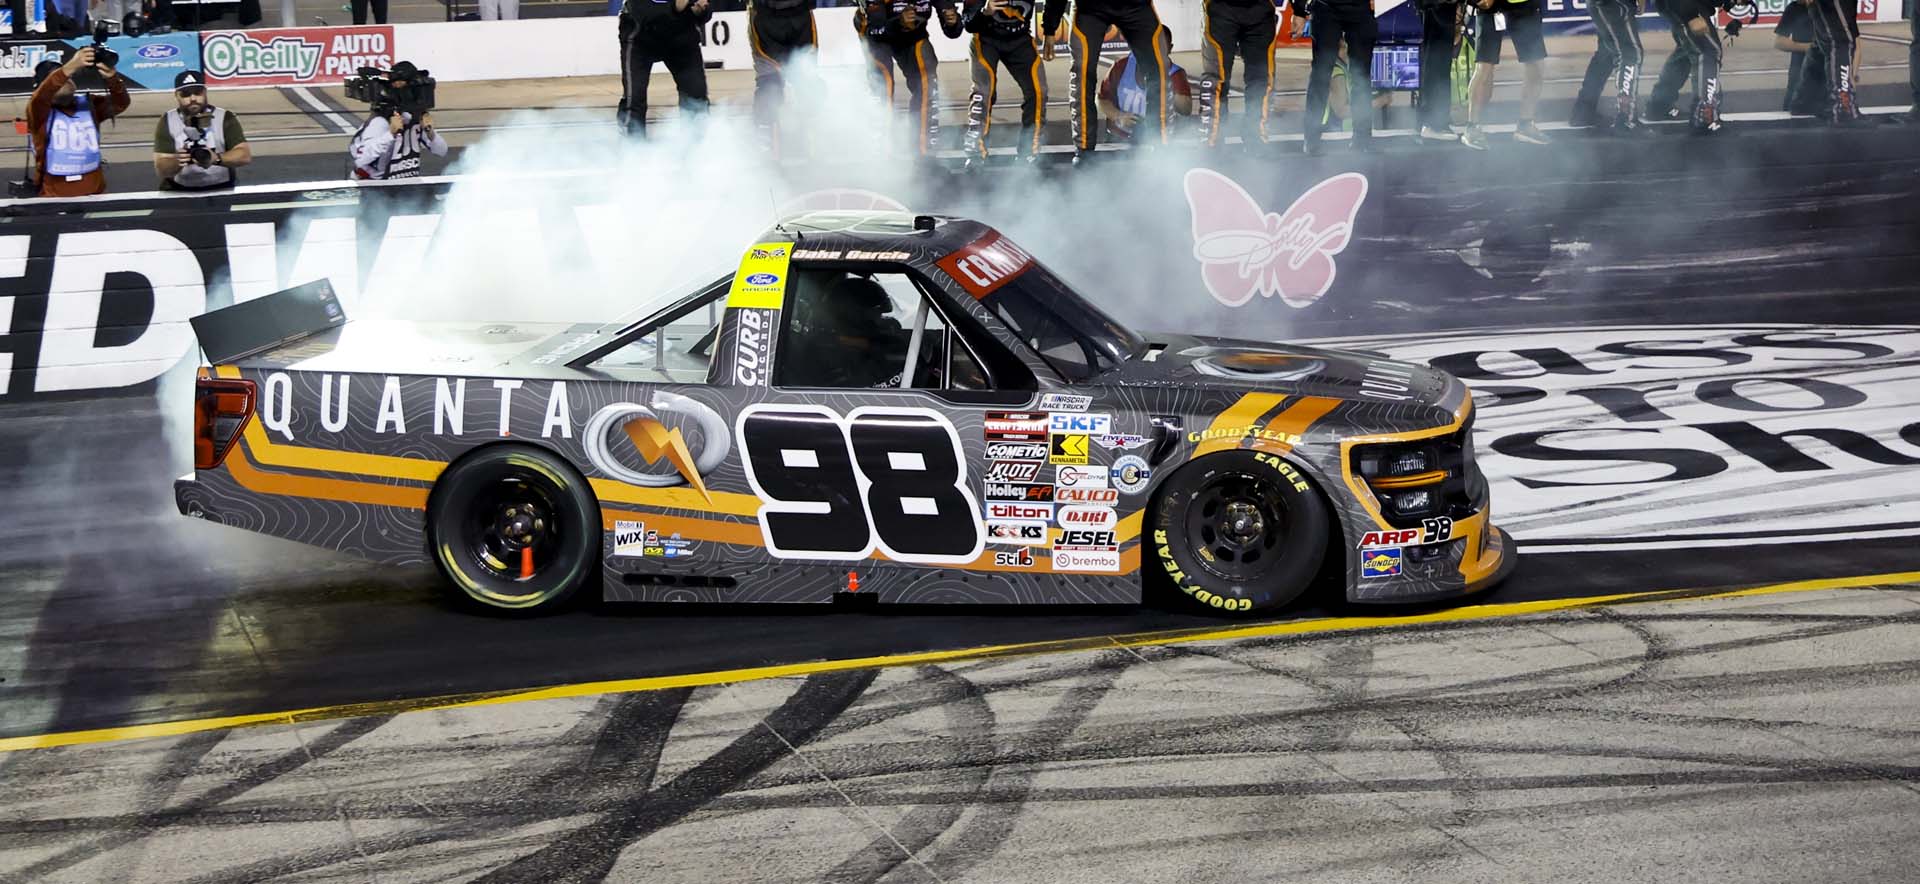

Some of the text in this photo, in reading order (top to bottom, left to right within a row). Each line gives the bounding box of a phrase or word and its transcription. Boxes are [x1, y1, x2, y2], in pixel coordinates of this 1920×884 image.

[143, 44, 173, 58] Ford
[331, 34, 386, 55] AUTO
[208, 38, 318, 73] O'Reilly
[325, 54, 392, 76] PARTS
[791, 249, 911, 260] Jake Garcia
[751, 273, 774, 285] Ford
[737, 308, 761, 387] CURB
[757, 310, 770, 387] RECORDS
[1428, 332, 1896, 381] ass
[263, 372, 573, 440] QUANTA
[1056, 395, 1086, 404] NASCAR
[1051, 415, 1108, 431] SKF
[988, 442, 1047, 458] COMETIC
[1489, 421, 1920, 489] Sh
[992, 463, 1037, 478] KLOTZ
[1254, 452, 1310, 493] EAGLE
[740, 403, 985, 564] 98
[986, 484, 1027, 500] Holley
[1057, 489, 1117, 501] CALICO
[990, 505, 1050, 518] tilton
[616, 531, 642, 546] WIX
[988, 525, 1042, 538] KOOKS
[1055, 531, 1116, 546] JESEL
[1361, 516, 1453, 546] ARP 98
[996, 547, 1033, 565] Stilo
[1073, 553, 1116, 566] brembo
[1365, 558, 1400, 569] SUNOCO
[1154, 529, 1252, 611] GOODYEAR
